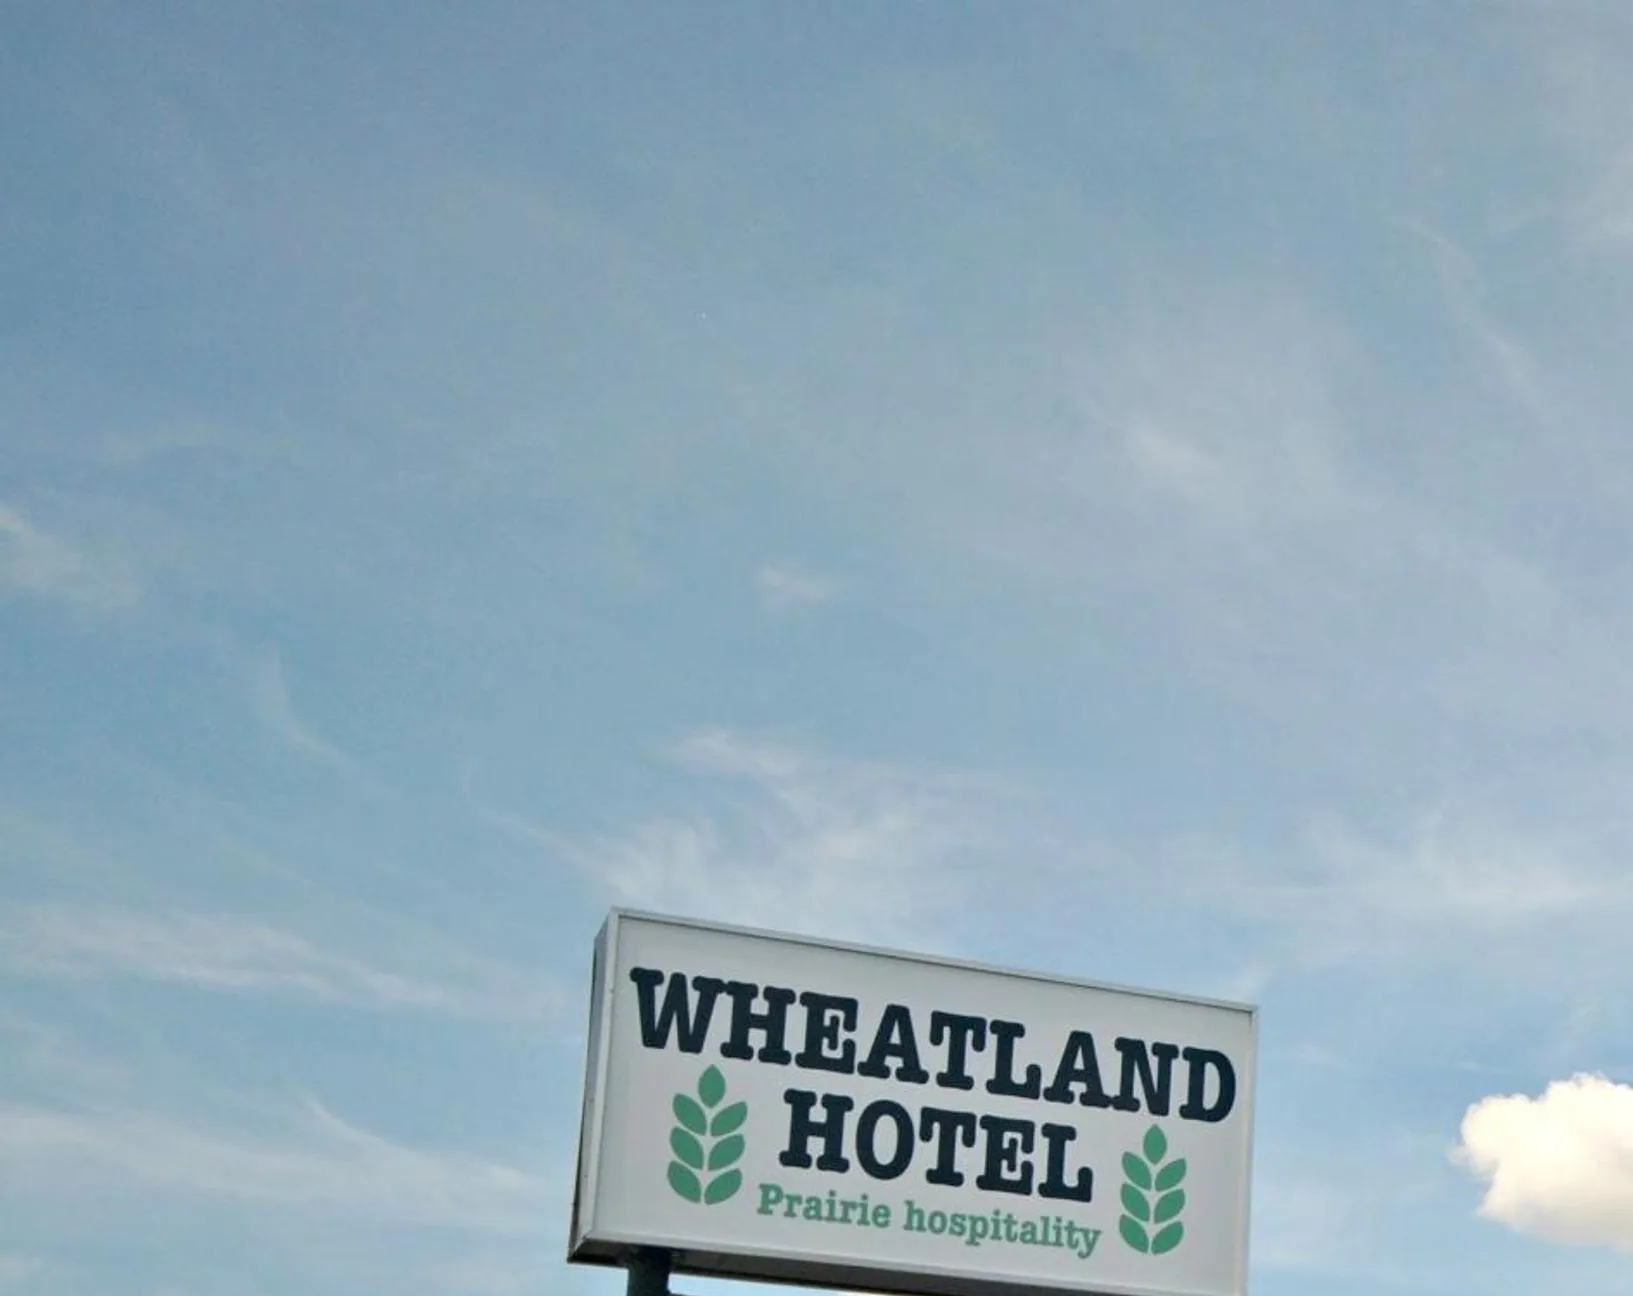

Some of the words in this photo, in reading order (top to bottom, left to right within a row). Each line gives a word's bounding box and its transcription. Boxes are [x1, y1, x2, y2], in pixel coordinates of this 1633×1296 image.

[629, 967, 1236, 1122] WHEATLAND
[778, 1088, 1093, 1202] HOTEL
[756, 1183, 891, 1228] Prairie
[903, 1200, 1101, 1259] hospitality
